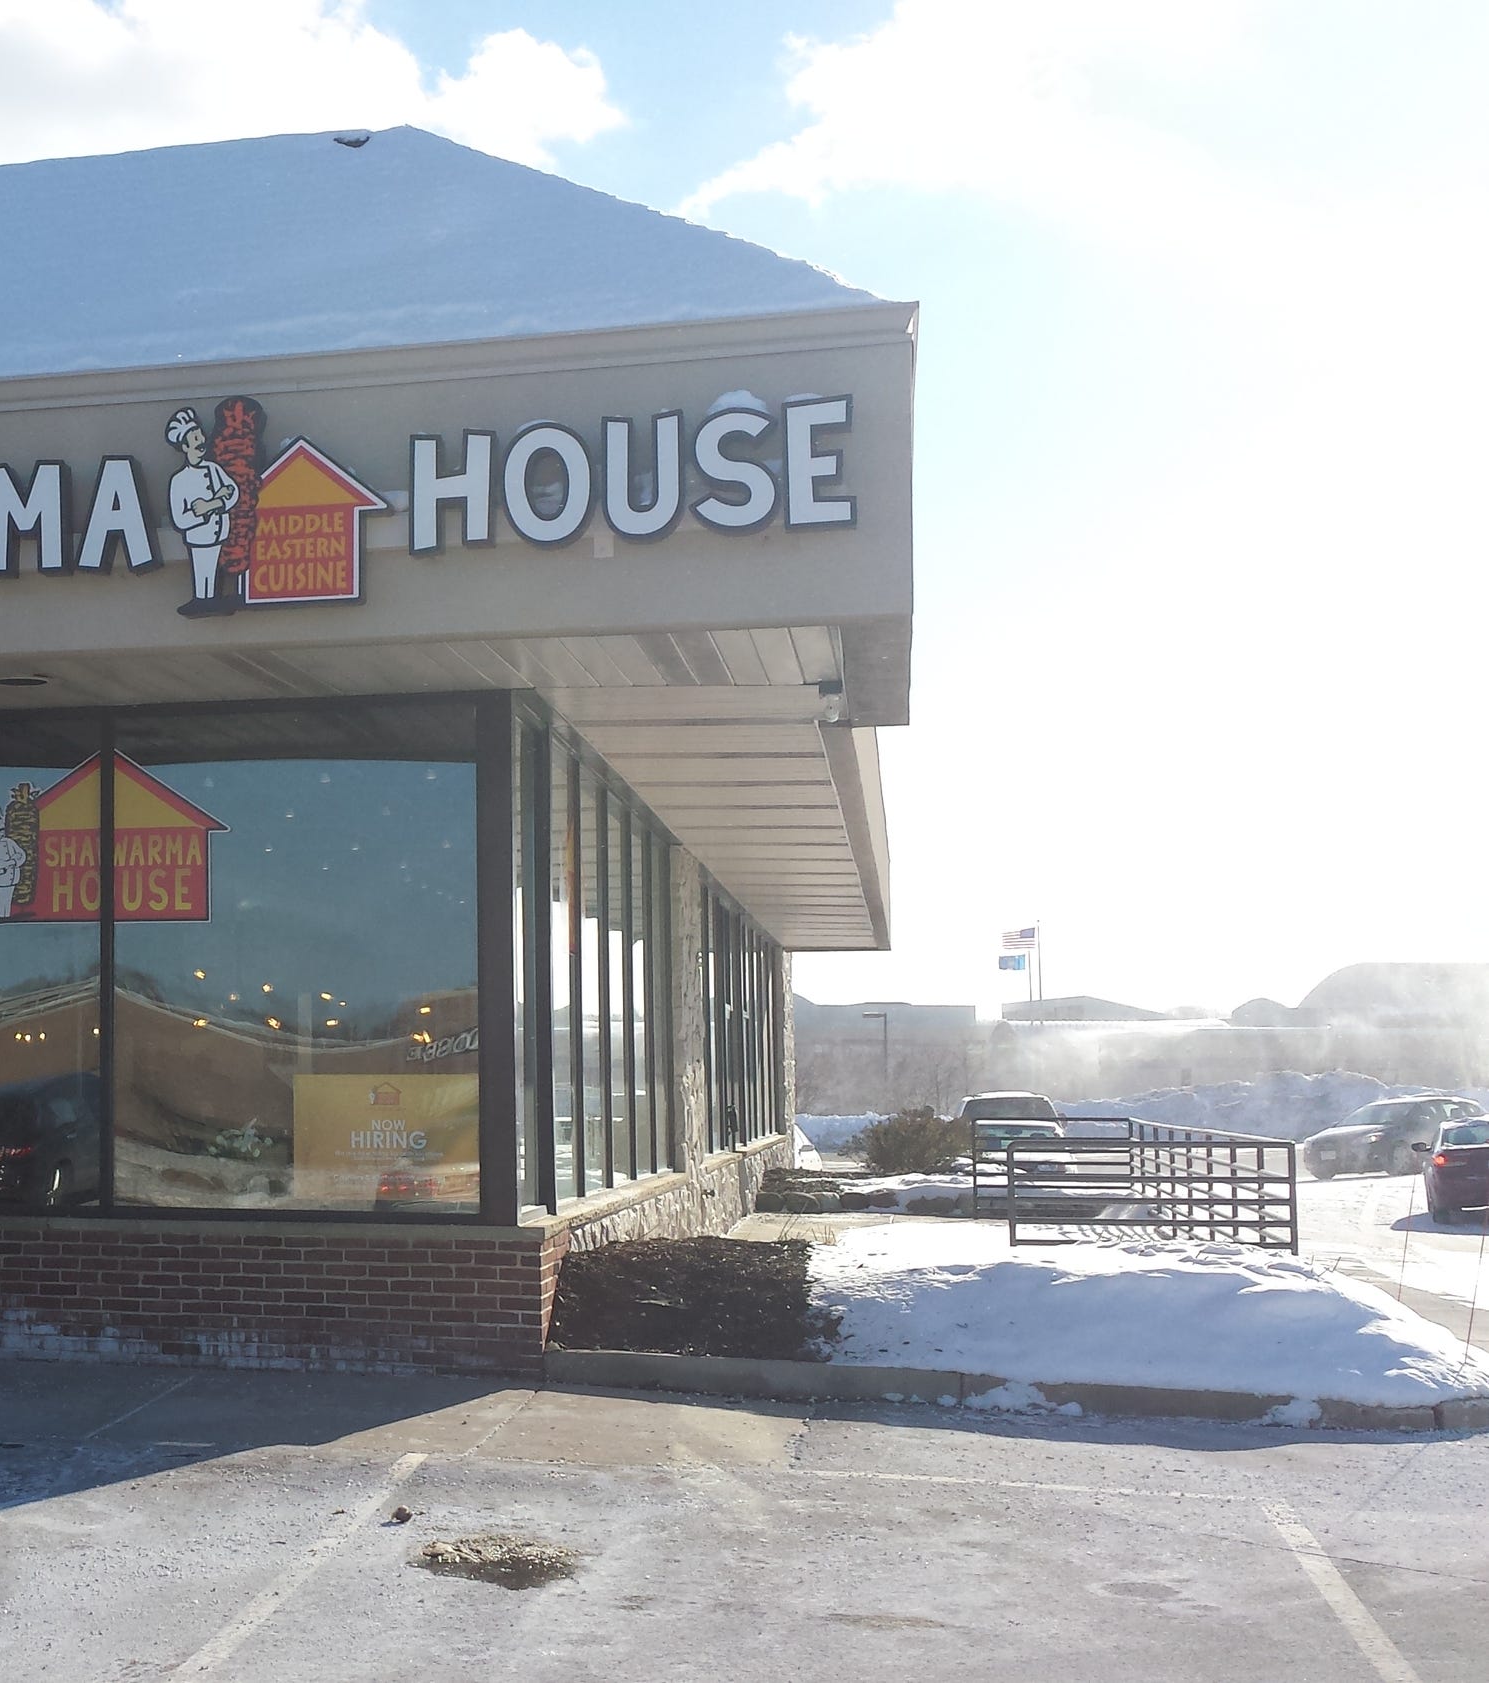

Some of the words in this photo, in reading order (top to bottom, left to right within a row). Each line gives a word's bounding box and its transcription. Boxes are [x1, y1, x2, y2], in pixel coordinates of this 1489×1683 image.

[409, 394, 857, 555] HOUSE
[255, 511, 344, 537] MIDDLE
[255, 535, 346, 561] EASTERN
[254, 560, 347, 593] CUISINE
[45, 834, 202, 868] SHAWARMA
[52, 867, 192, 912] HOUSE
[350, 1130, 427, 1149] HIRING
[371, 1119, 406, 1131] NOW
